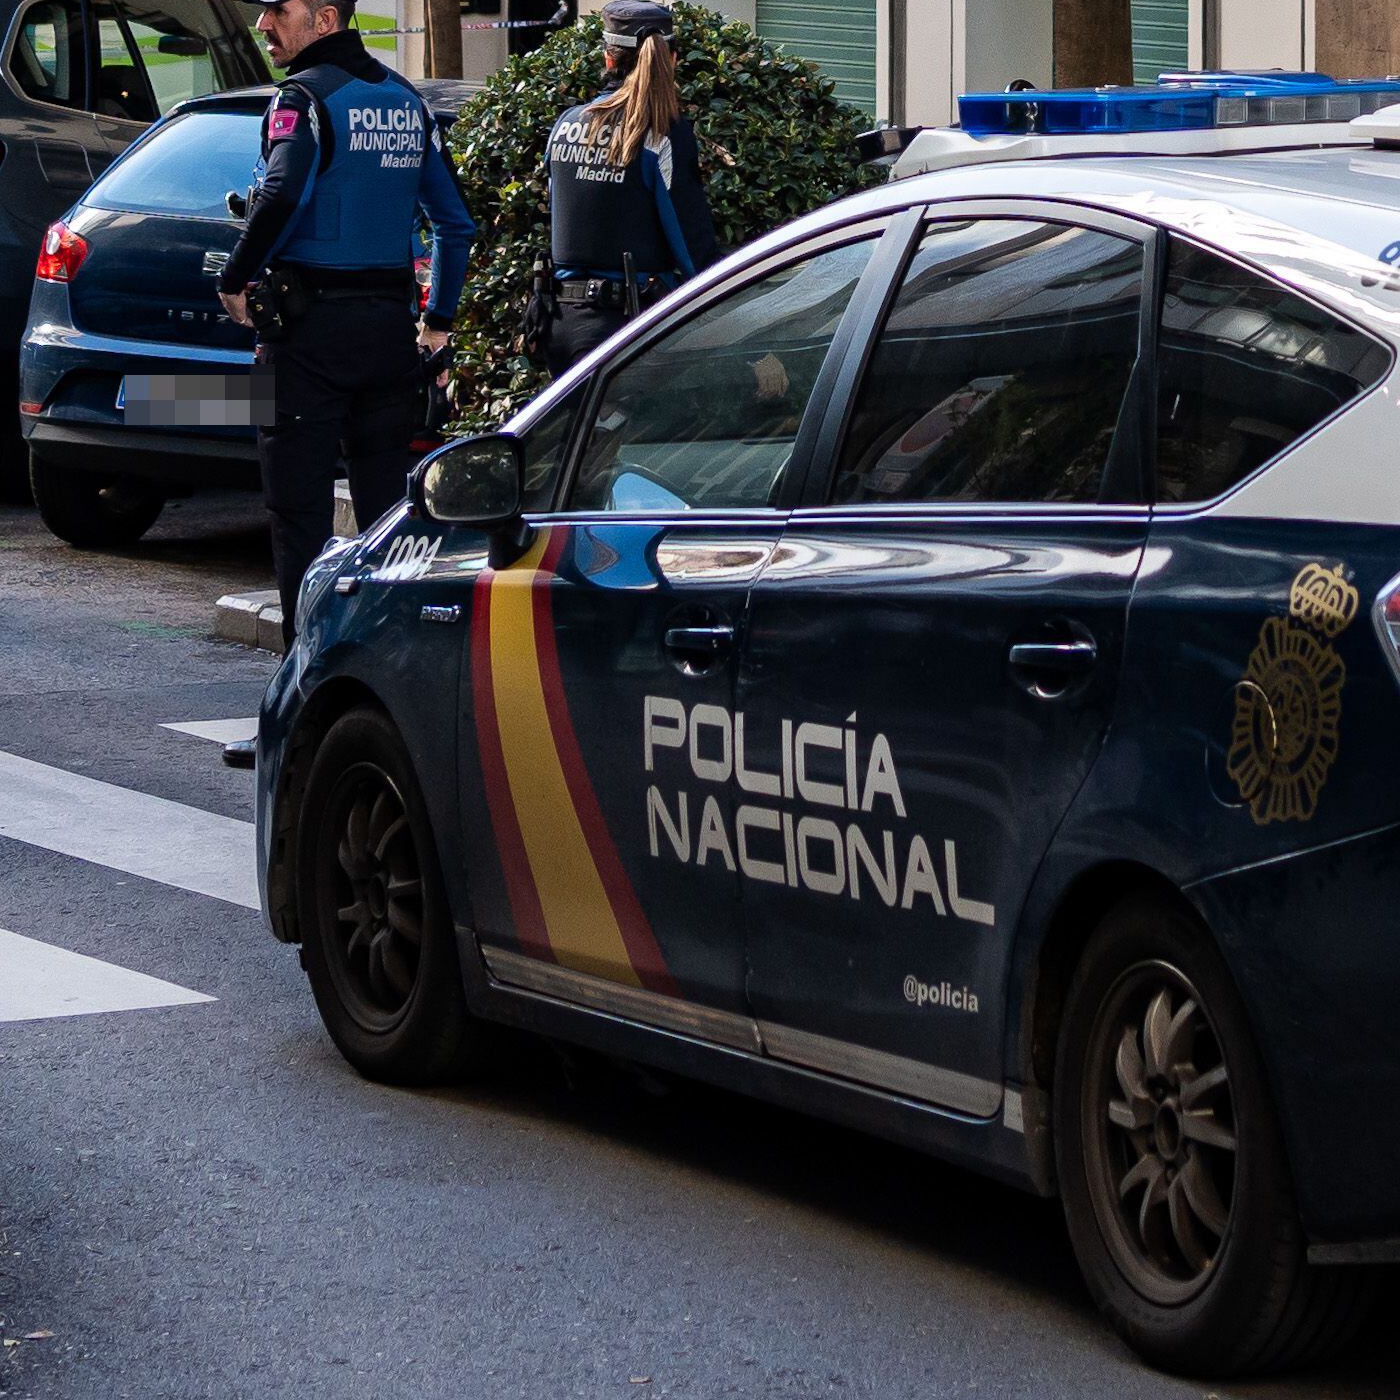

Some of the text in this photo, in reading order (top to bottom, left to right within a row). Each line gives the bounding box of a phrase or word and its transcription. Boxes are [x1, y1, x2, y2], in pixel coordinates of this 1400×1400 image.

[348, 101, 423, 131] POLICÍA
[349, 132, 424, 152] MUNICIPAL
[550, 143, 625, 167] MUNICIPL
[380, 153, 423, 169] Madrid
[575, 165, 626, 183] Madrid
[644, 695, 908, 818] POLICÍA
[646, 784, 995, 927] NACIONAL
[903, 974, 979, 1013] @policia
